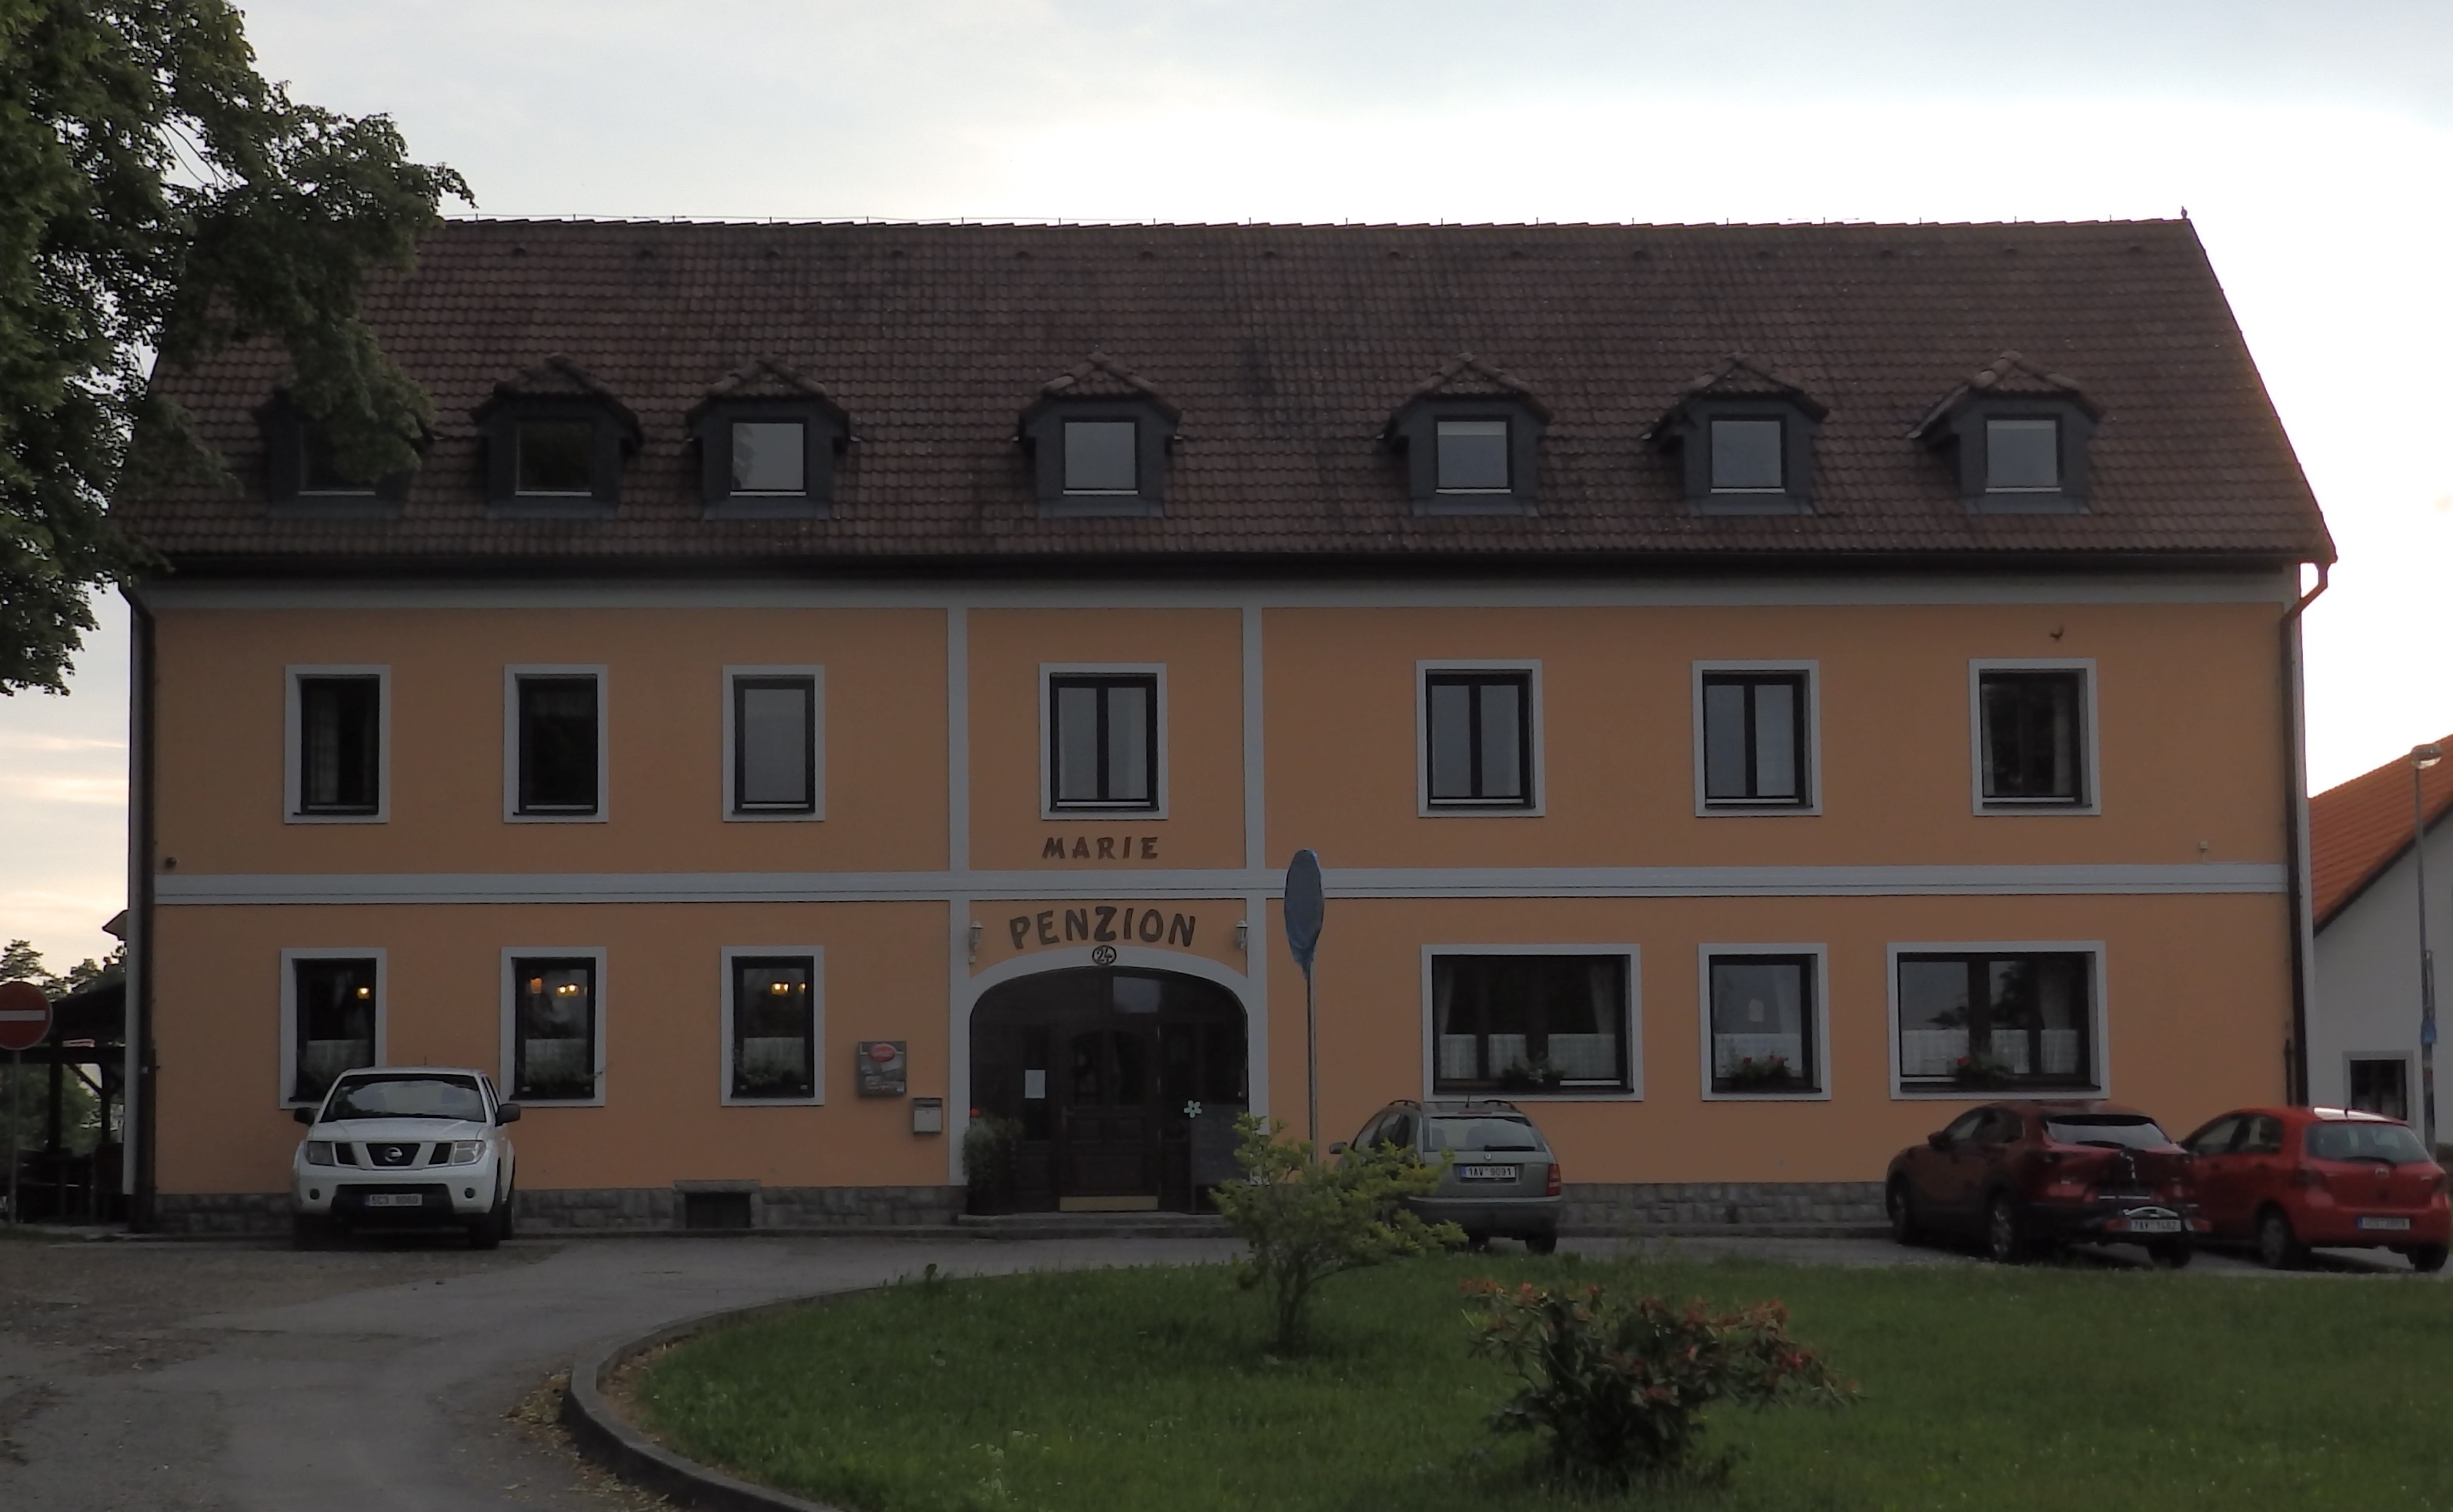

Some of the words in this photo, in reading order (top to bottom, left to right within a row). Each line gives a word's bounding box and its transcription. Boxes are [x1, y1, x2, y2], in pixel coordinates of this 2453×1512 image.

[1042, 836, 1158, 860] MARIE
[1010, 906, 1196, 950] PENZION
[1096, 947, 1113, 963] 24
[1469, 1167, 1483, 1176] 1AV
